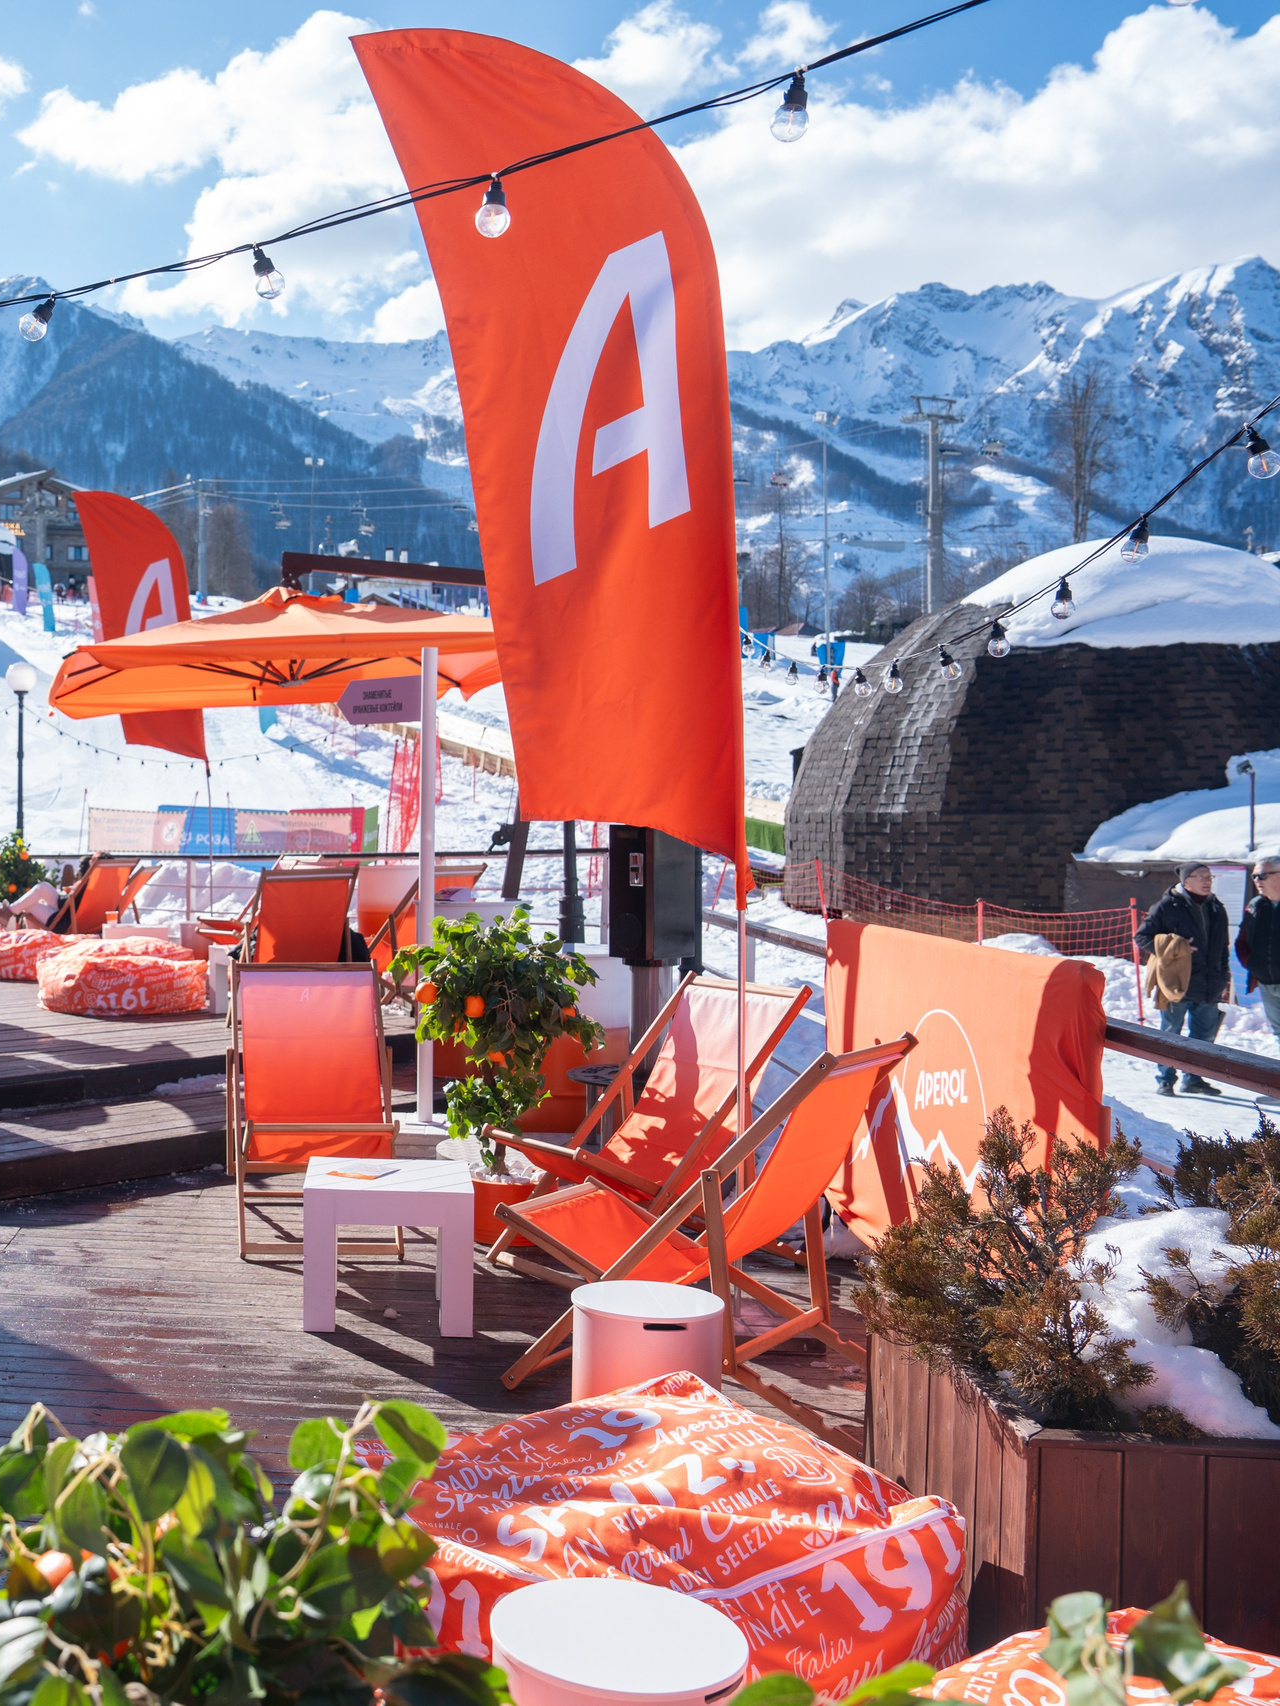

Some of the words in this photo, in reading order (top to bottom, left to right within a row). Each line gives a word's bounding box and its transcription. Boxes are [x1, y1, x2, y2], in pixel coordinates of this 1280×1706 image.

[530, 230, 691, 586] A
[124, 557, 178, 636] A
[352, 704, 379, 714] ОРАНЖЕВЫЕ
[380, 701, 403, 712] КОКТЕЙЛИ
[362, 689, 392, 700] ЗНАМЕНИТЫЕ
[195, 834, 230, 845] РОЗА
[914, 1068, 968, 1110] APEROL
[689, 1426, 787, 1456] RITUAL
[699, 1477, 782, 1516] RIGINALE
[620, 1526, 693, 1582] Ritual
[785, 1633, 853, 1682] Italia
